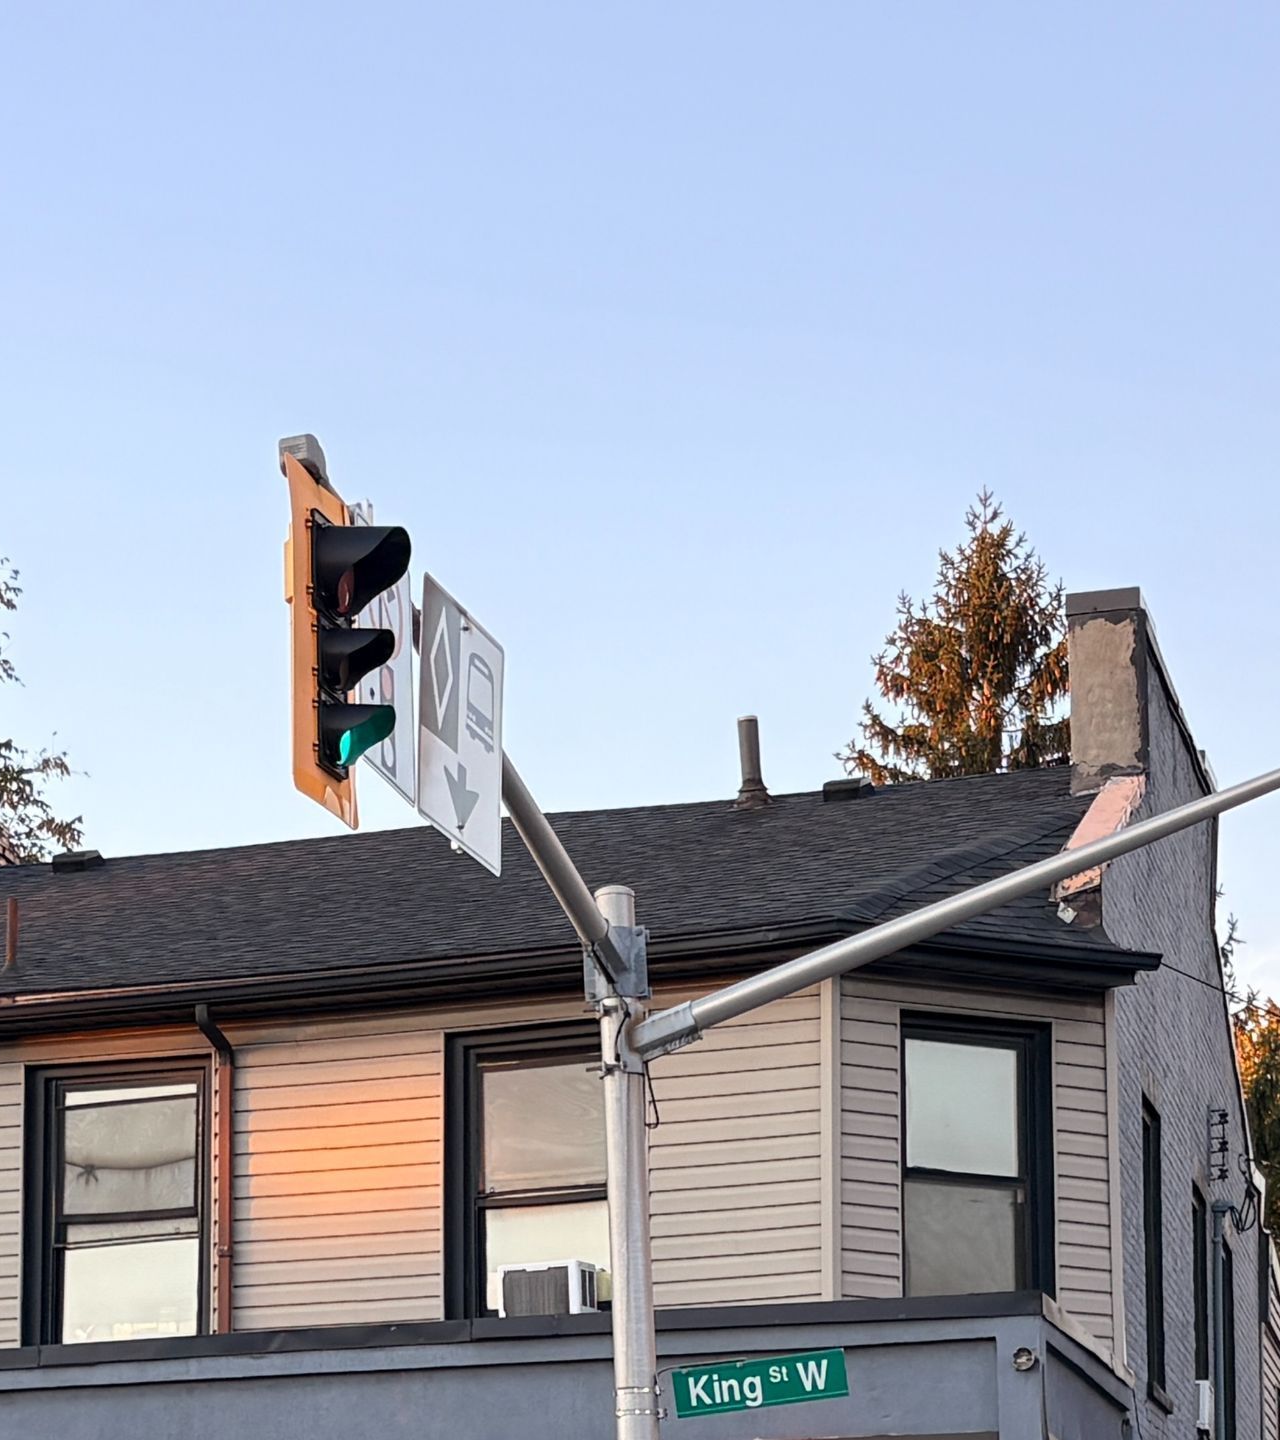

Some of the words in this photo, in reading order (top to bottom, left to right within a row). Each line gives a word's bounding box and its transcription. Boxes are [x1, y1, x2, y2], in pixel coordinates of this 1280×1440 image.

[688, 1374, 763, 1407] King
[769, 1366, 789, 1383] St
[796, 1359, 828, 1392] W
